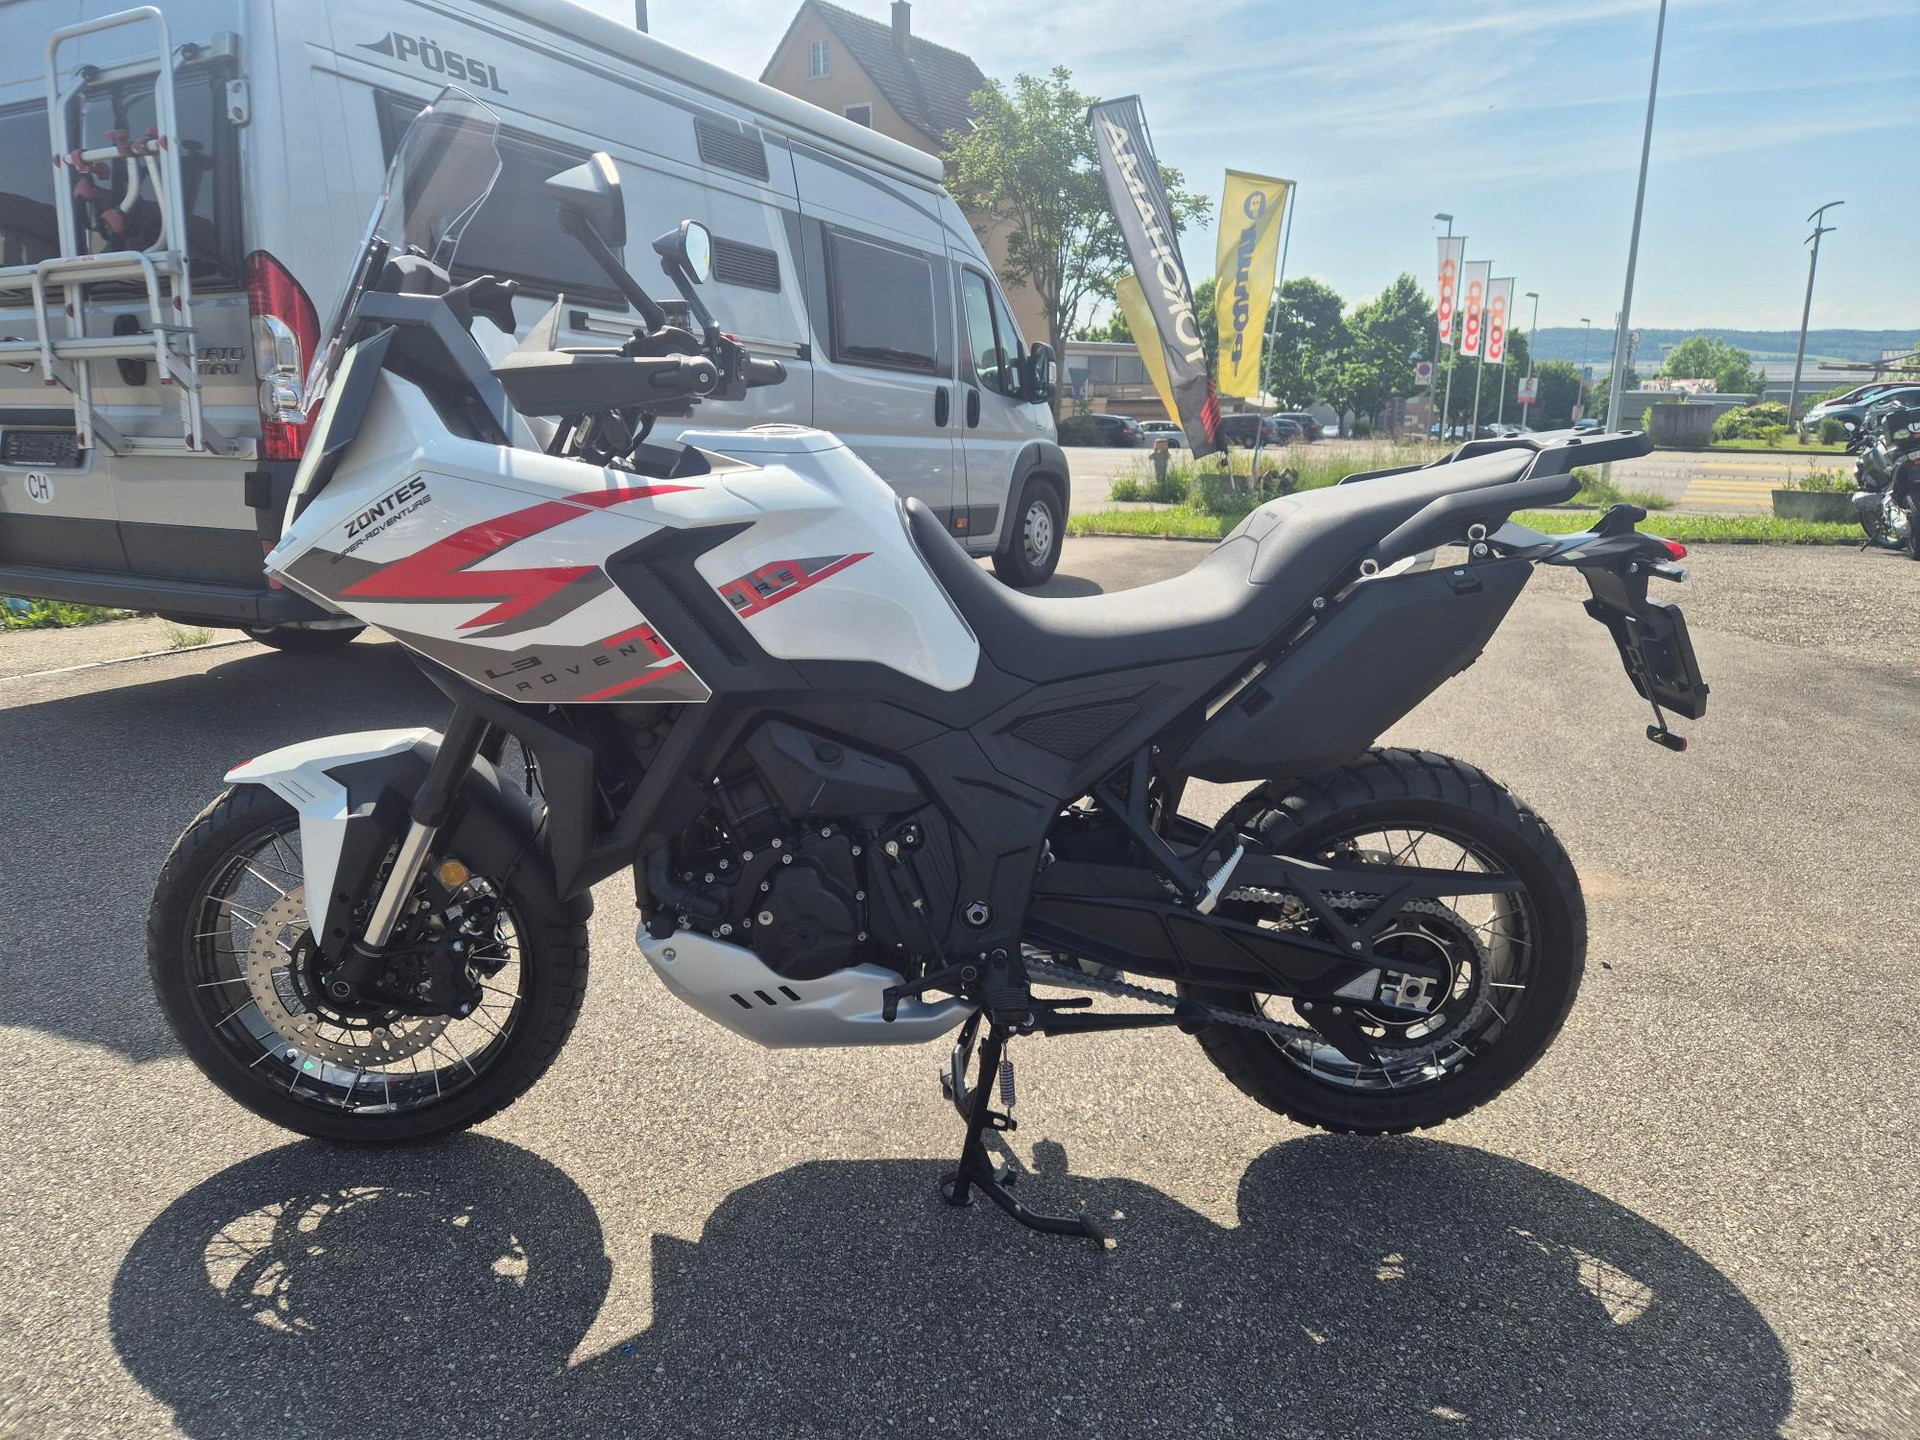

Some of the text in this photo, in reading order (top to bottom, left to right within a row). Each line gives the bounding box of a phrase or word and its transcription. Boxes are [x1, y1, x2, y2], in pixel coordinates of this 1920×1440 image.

[392, 32, 509, 96] PÖSSL
[27, 474, 50, 500] CH
[344, 476, 427, 539] ZONTES
